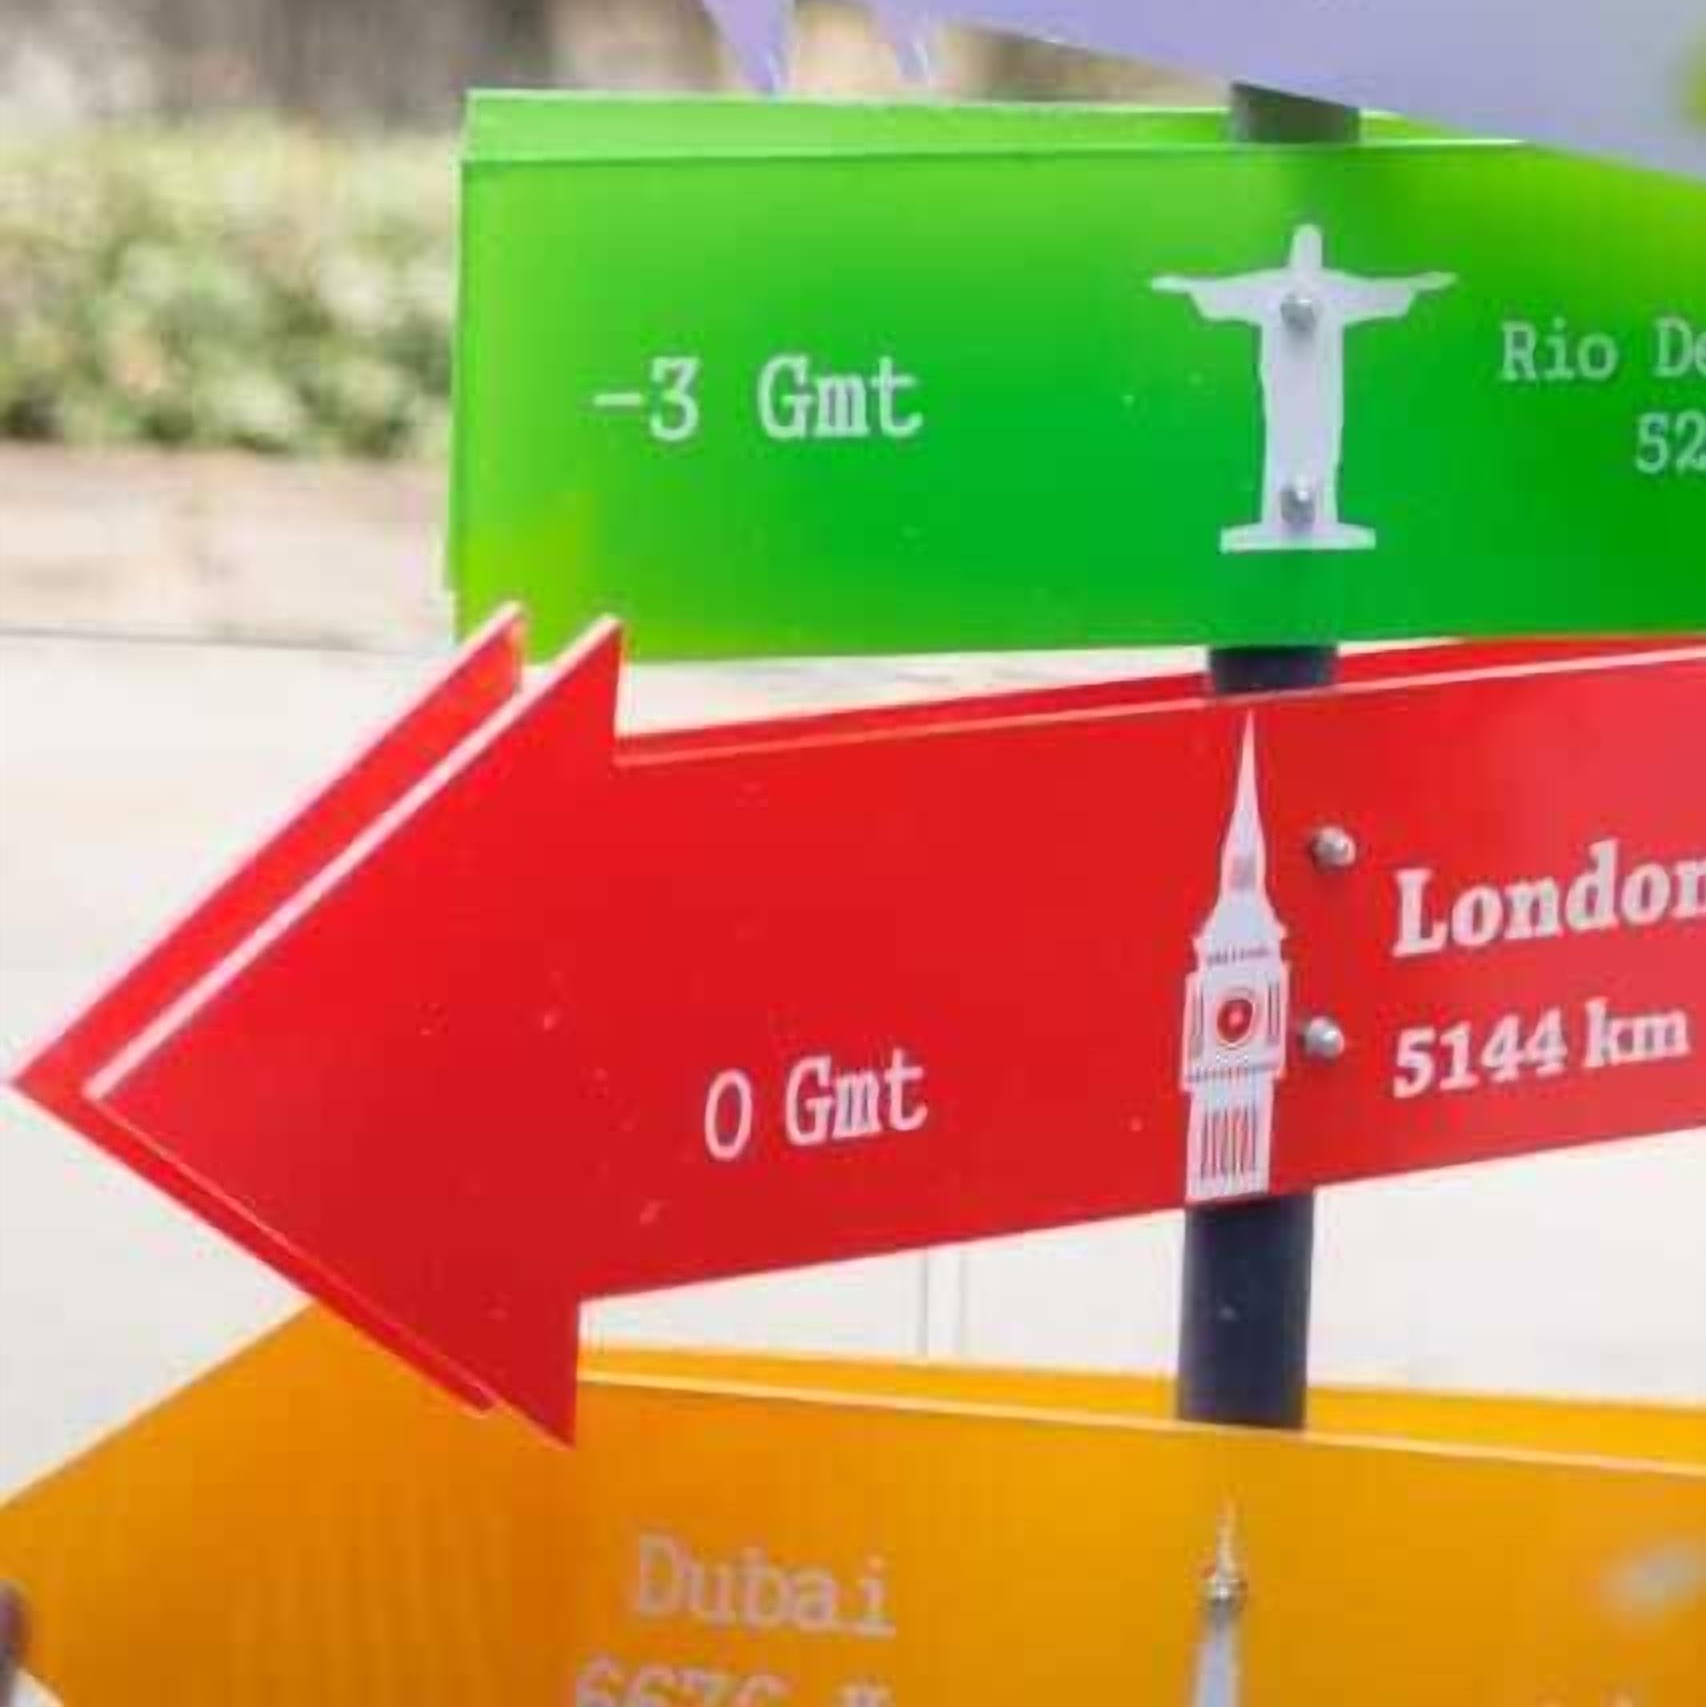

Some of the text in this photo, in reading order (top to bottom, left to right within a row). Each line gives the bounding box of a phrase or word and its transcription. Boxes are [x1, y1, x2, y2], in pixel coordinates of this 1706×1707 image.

[1499, 316, 1620, 382] Rio
[593, 352, 924, 441] -3 Gmt
[1582, 995, 1692, 1070] km
[704, 1046, 929, 1161] 0 Gmt
[628, 1532, 897, 1639] Dubai
